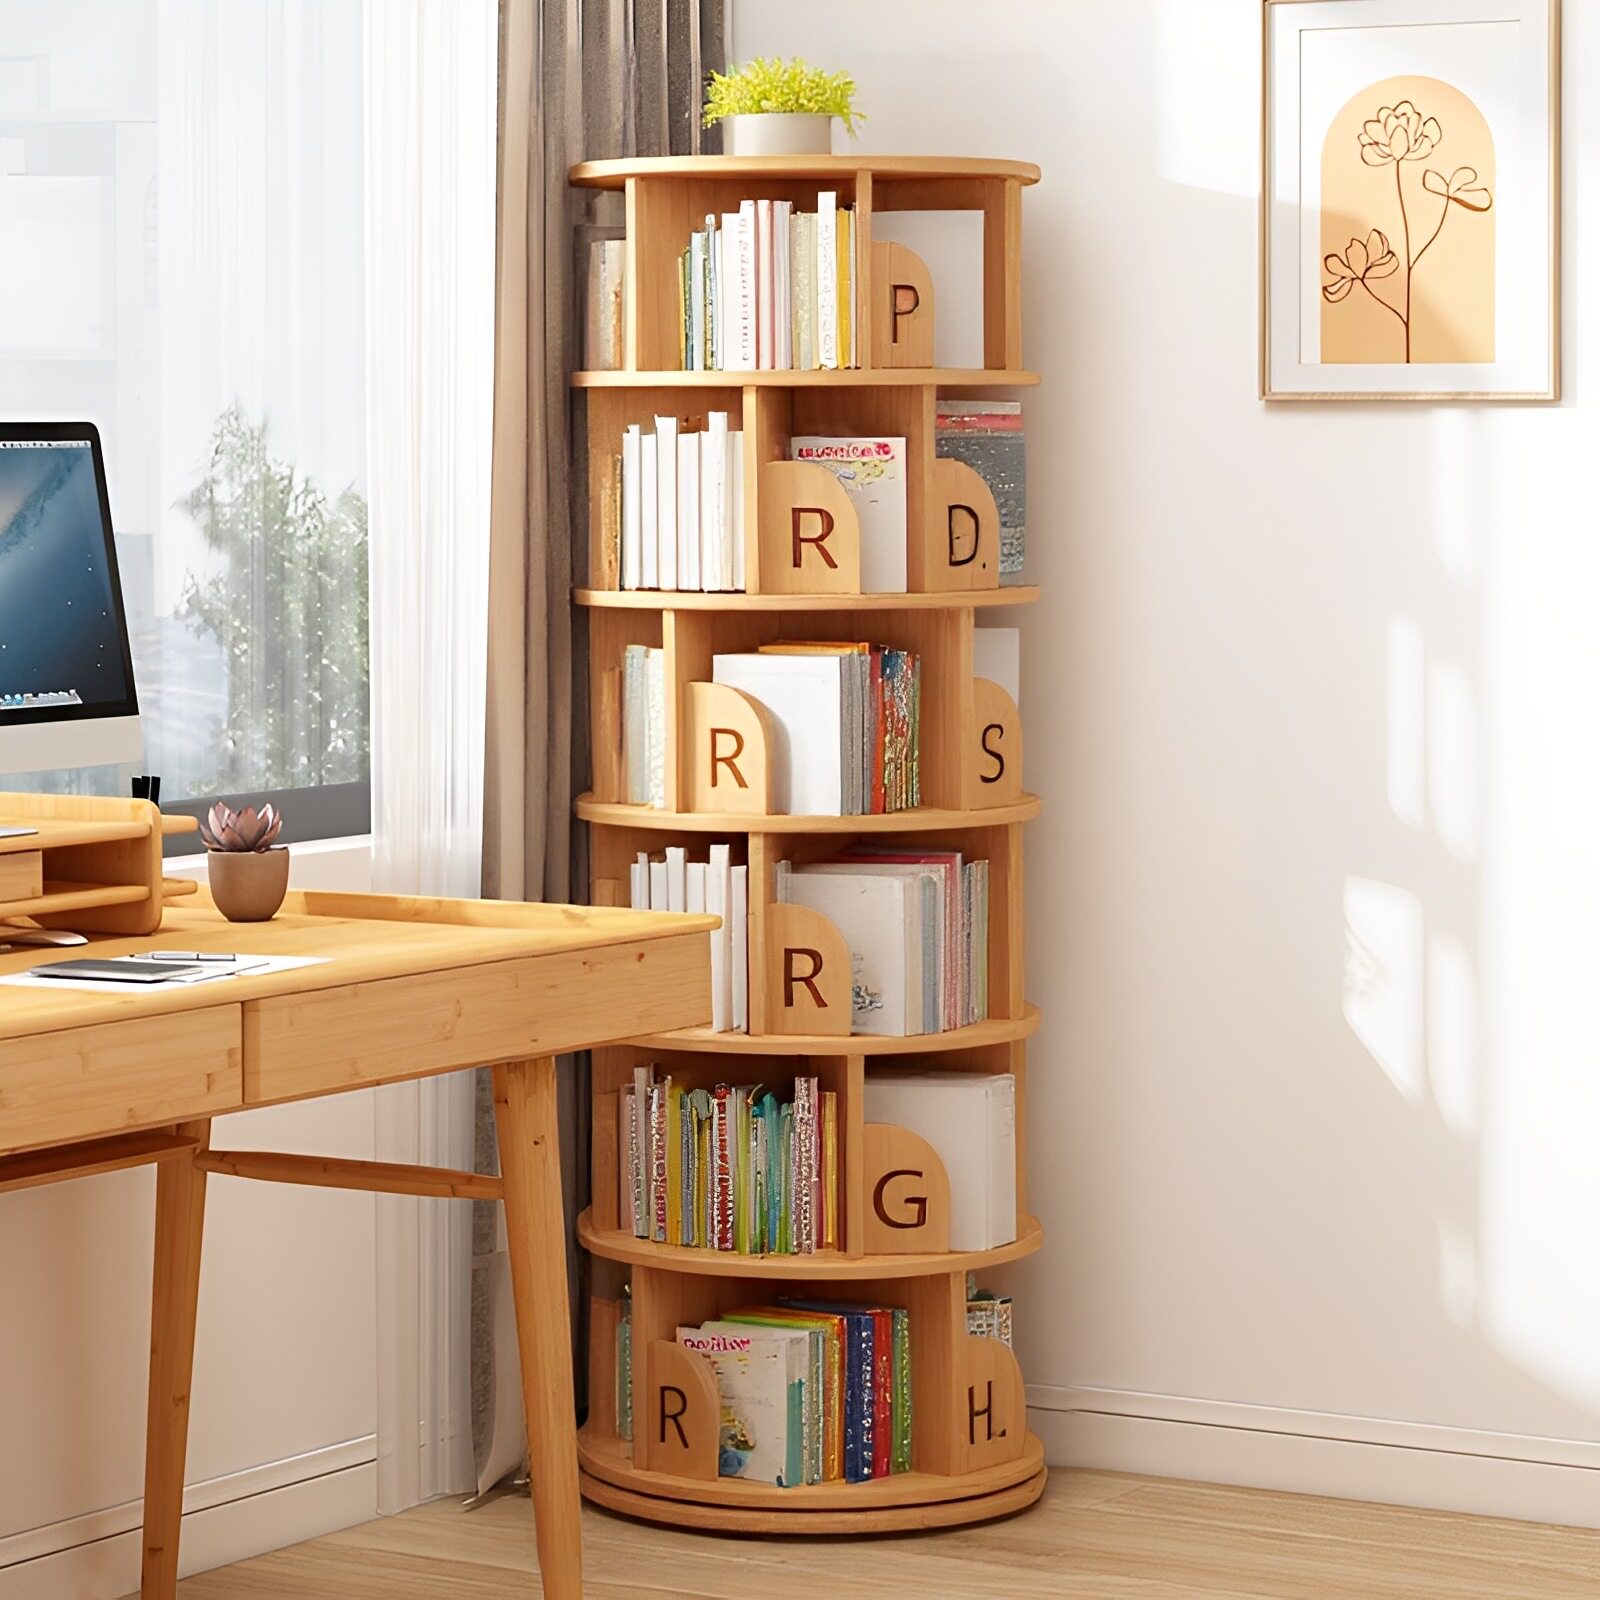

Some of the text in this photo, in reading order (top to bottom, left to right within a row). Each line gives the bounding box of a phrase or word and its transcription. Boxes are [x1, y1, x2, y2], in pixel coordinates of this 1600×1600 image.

[890, 285, 919, 343] P
[792, 507, 838, 569] R
[710, 728, 749, 788] R
[980, 724, 1004, 783] S
[783, 947, 828, 1008] R
[873, 1169, 927, 1229] G
[659, 1386, 690, 1448] R
